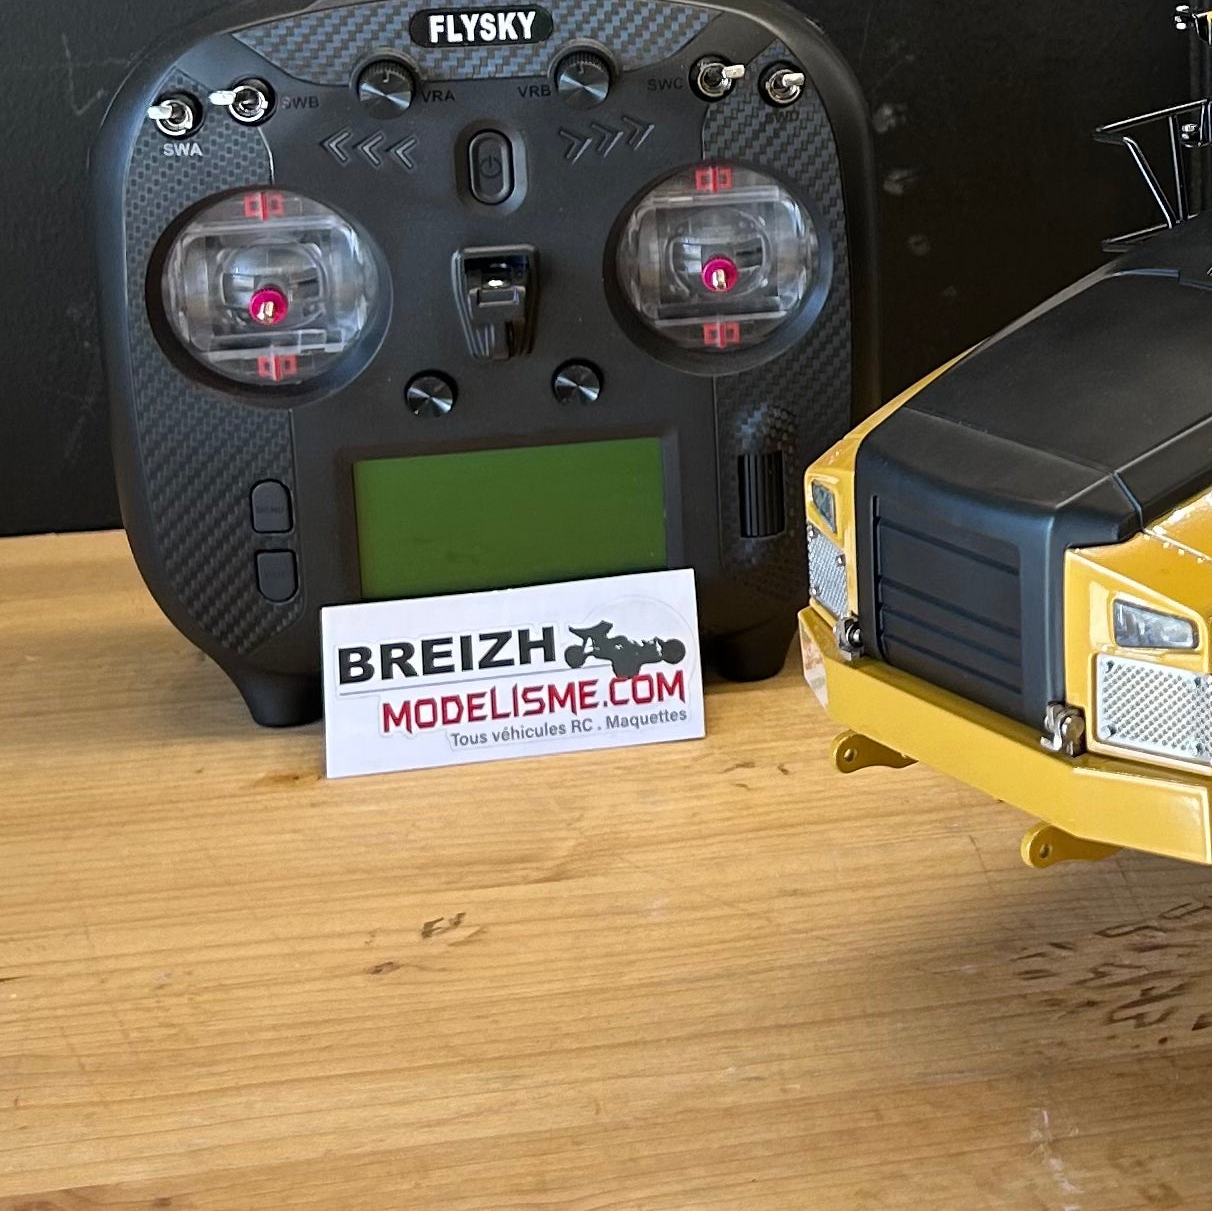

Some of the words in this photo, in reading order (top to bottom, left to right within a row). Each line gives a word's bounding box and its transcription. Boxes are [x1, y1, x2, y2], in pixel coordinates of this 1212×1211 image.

[428, 11, 536, 43] FLYSKY
[518, 84, 552, 98] VRB
[647, 78, 684, 91] SWC
[281, 95, 320, 109] SWB
[421, 89, 456, 103] VRA
[163, 142, 203, 157] SWA
[338, 625, 557, 686] BREIZH
[382, 669, 686, 734] MODELISME.COM
[450, 731, 488, 748] Tous
[491, 723, 567, 743] véhicules
[570, 719, 594, 734] RC
[605, 707, 688, 733] Maquettes
